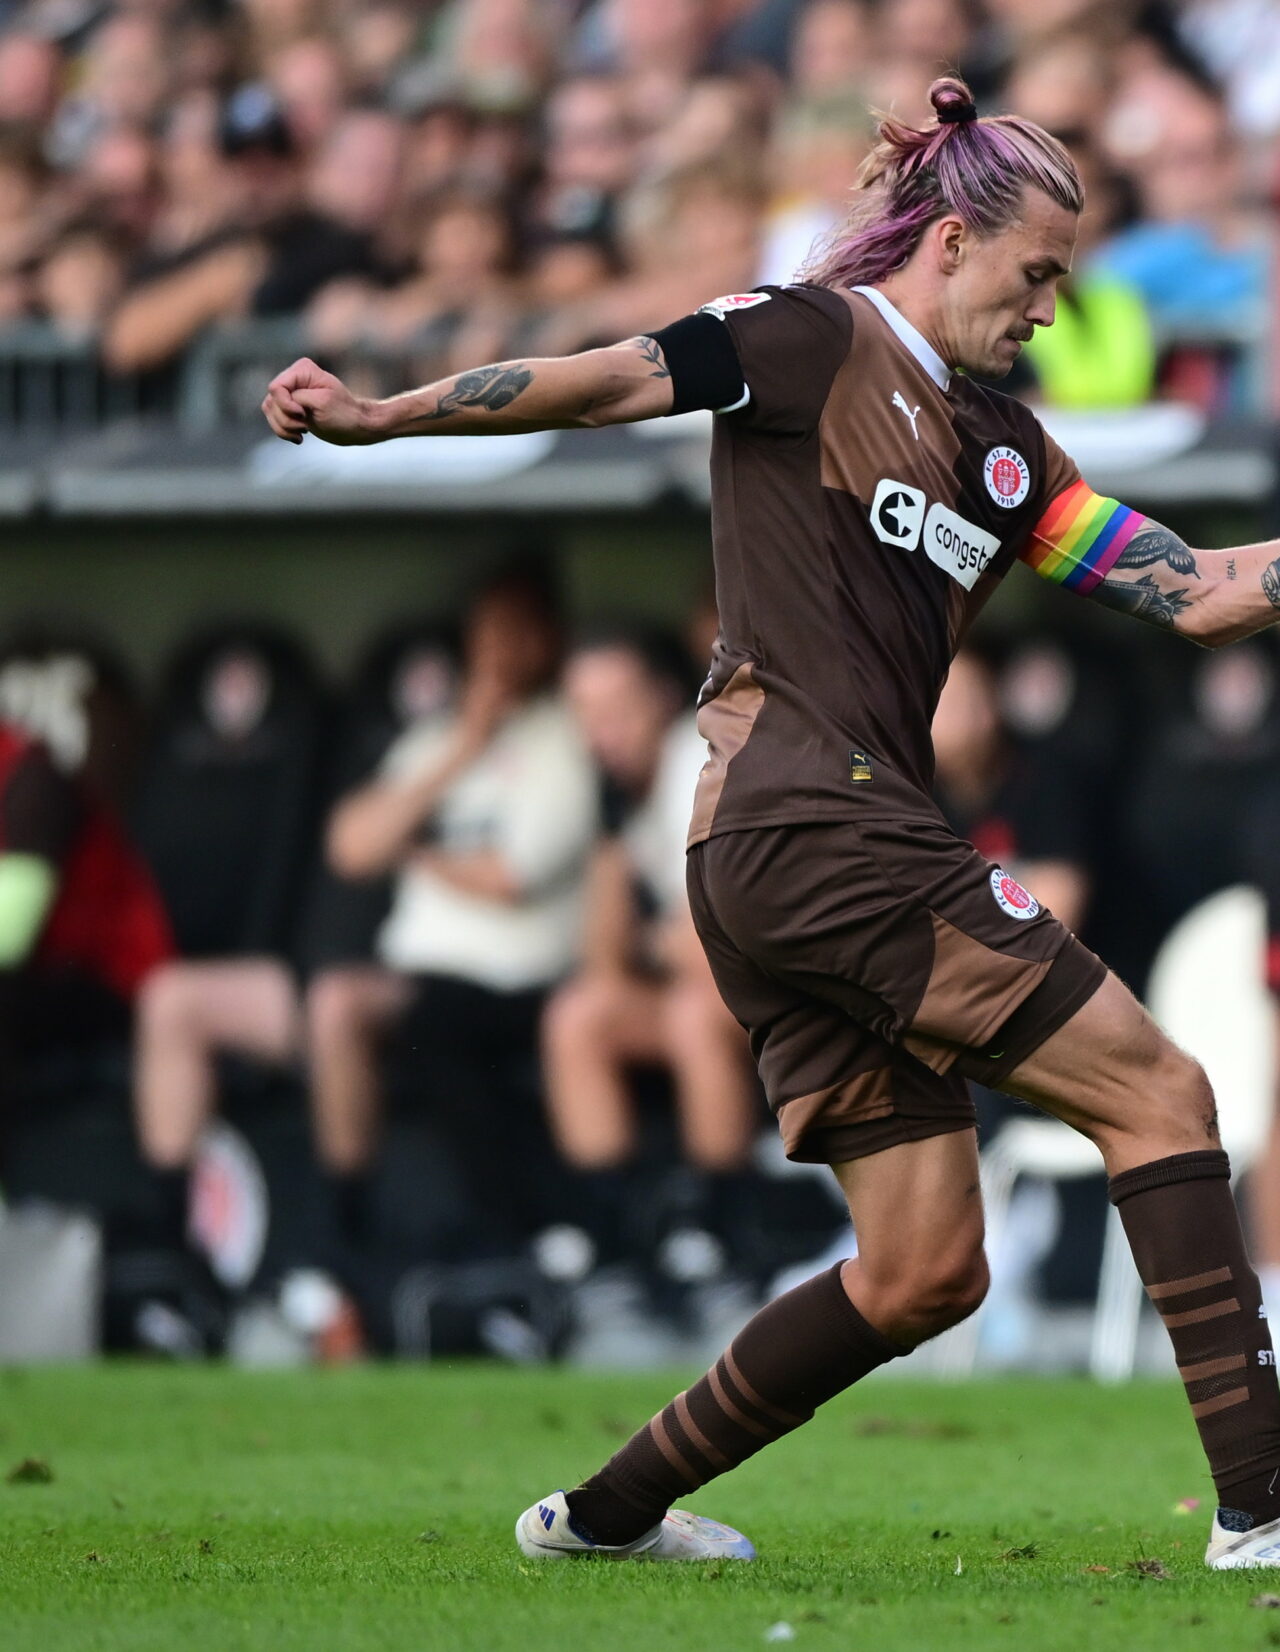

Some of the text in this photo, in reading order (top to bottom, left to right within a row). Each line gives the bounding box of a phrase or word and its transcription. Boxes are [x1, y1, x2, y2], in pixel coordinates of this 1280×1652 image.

[986, 459, 993, 472] FC
[1006, 450, 1028, 479] PAULI
[997, 495, 1015, 506] 1910
